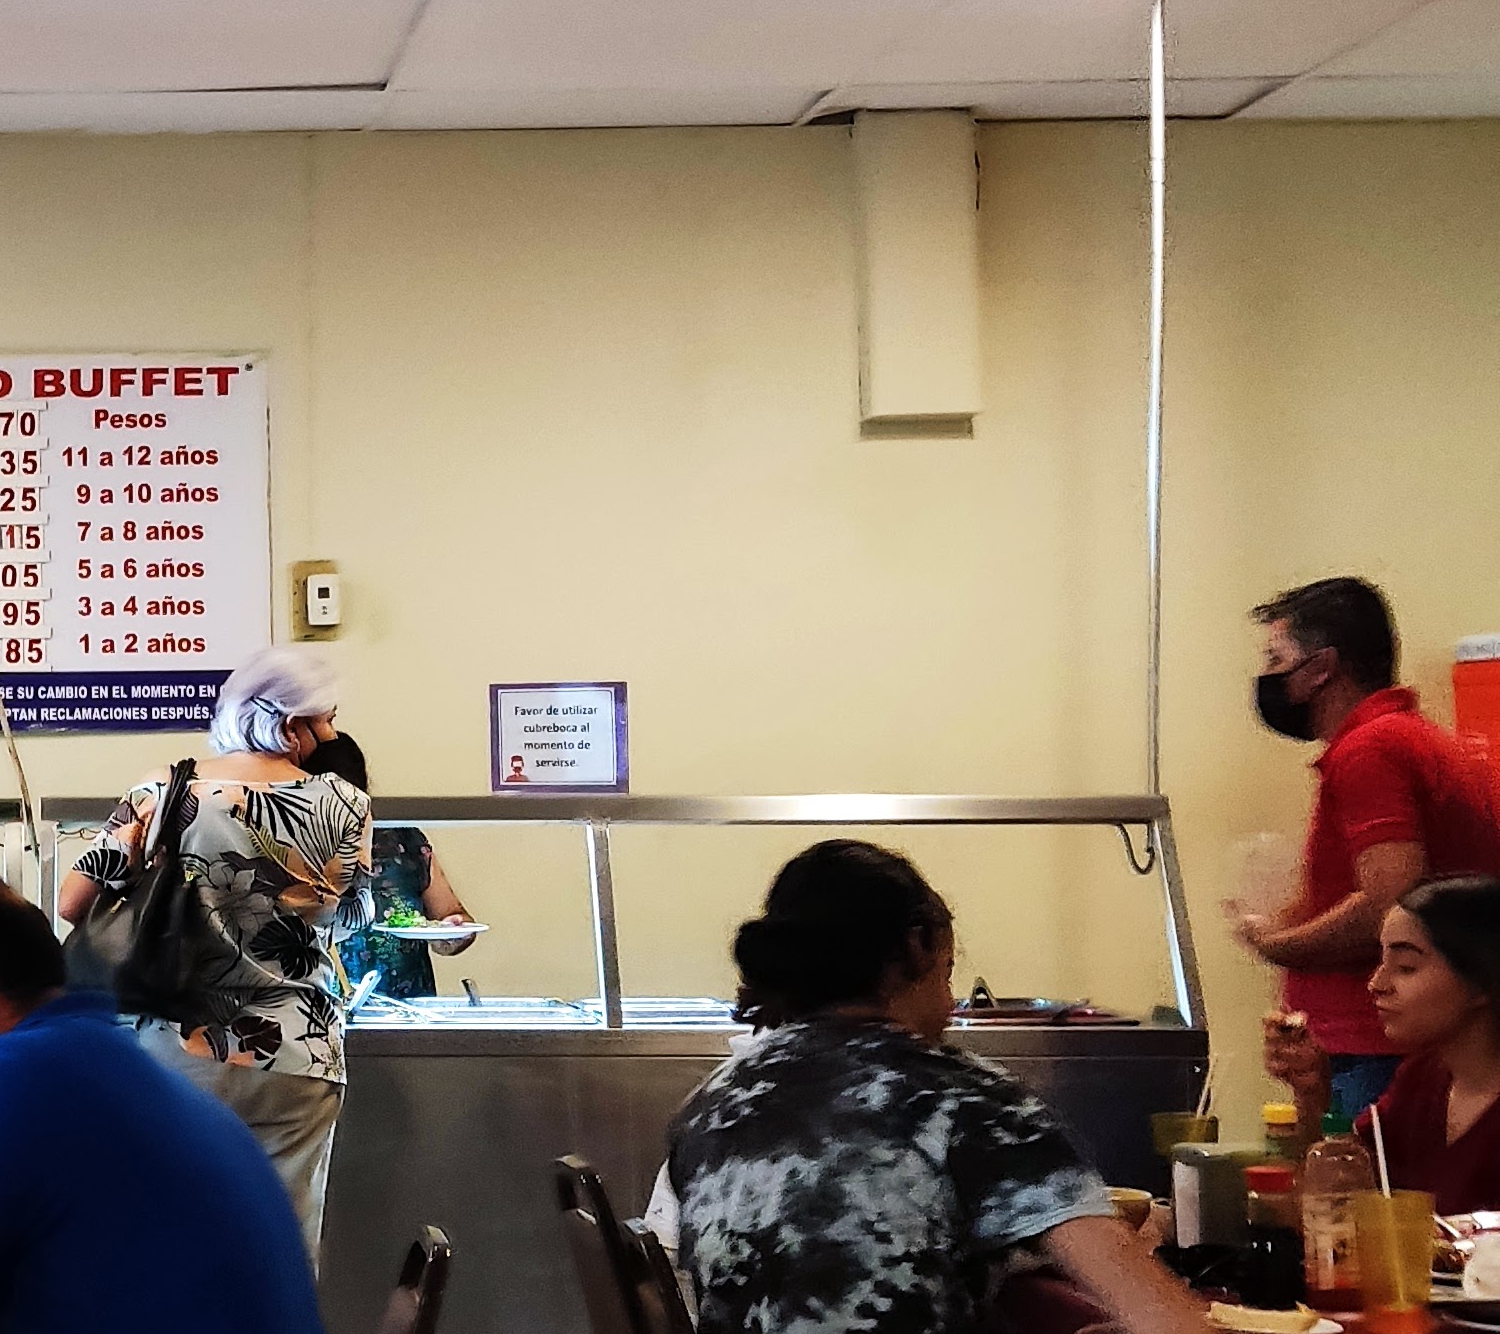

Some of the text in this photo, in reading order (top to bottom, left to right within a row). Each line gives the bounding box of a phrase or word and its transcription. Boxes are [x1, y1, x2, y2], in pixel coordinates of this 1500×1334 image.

[34, 367, 239, 398] BUFFET
[95, 409, 166, 429] Pesos
[63, 447, 87, 466] 11
[100, 452, 113, 466] a
[123, 446, 151, 465] 12
[160, 445, 218, 465] años
[77, 484, 90, 504] 9
[100, 489, 113, 504] a
[124, 483, 151, 503] 10
[161, 483, 218, 502] años
[6, 525, 41, 550] 15
[78, 522, 91, 541] 7
[100, 527, 113, 541] a
[123, 521, 136, 541] 8
[146, 521, 203, 540] años
[79, 559, 91, 578] 5
[101, 564, 114, 578] a
[124, 558, 137, 578] 6
[146, 558, 204, 578] años
[3, 600, 41, 626] 95
[79, 597, 91, 616] 3
[101, 602, 114, 616] a
[124, 596, 138, 615] 4
[147, 596, 204, 615] años
[5, 637, 43, 664] 85
[80, 634, 89, 653] 1
[102, 639, 115, 653] a
[125, 634, 138, 653] 2
[148, 633, 205, 653] años
[17, 687, 34, 699] SU
[38, 686, 87, 699] CAMBIO
[92, 686, 108, 698] EN
[112, 686, 127, 698] EL
[132, 685, 195, 698] MOMENTO
[199, 685, 215, 697] EN
[40, 708, 147, 720] RECLAMACIONES
[152, 704, 215, 720] DESPUÉS.
[515, 705, 598, 715] Favor de utilizar
[524, 723, 589, 732] cubreboca al
[524, 740, 590, 749] momento de
